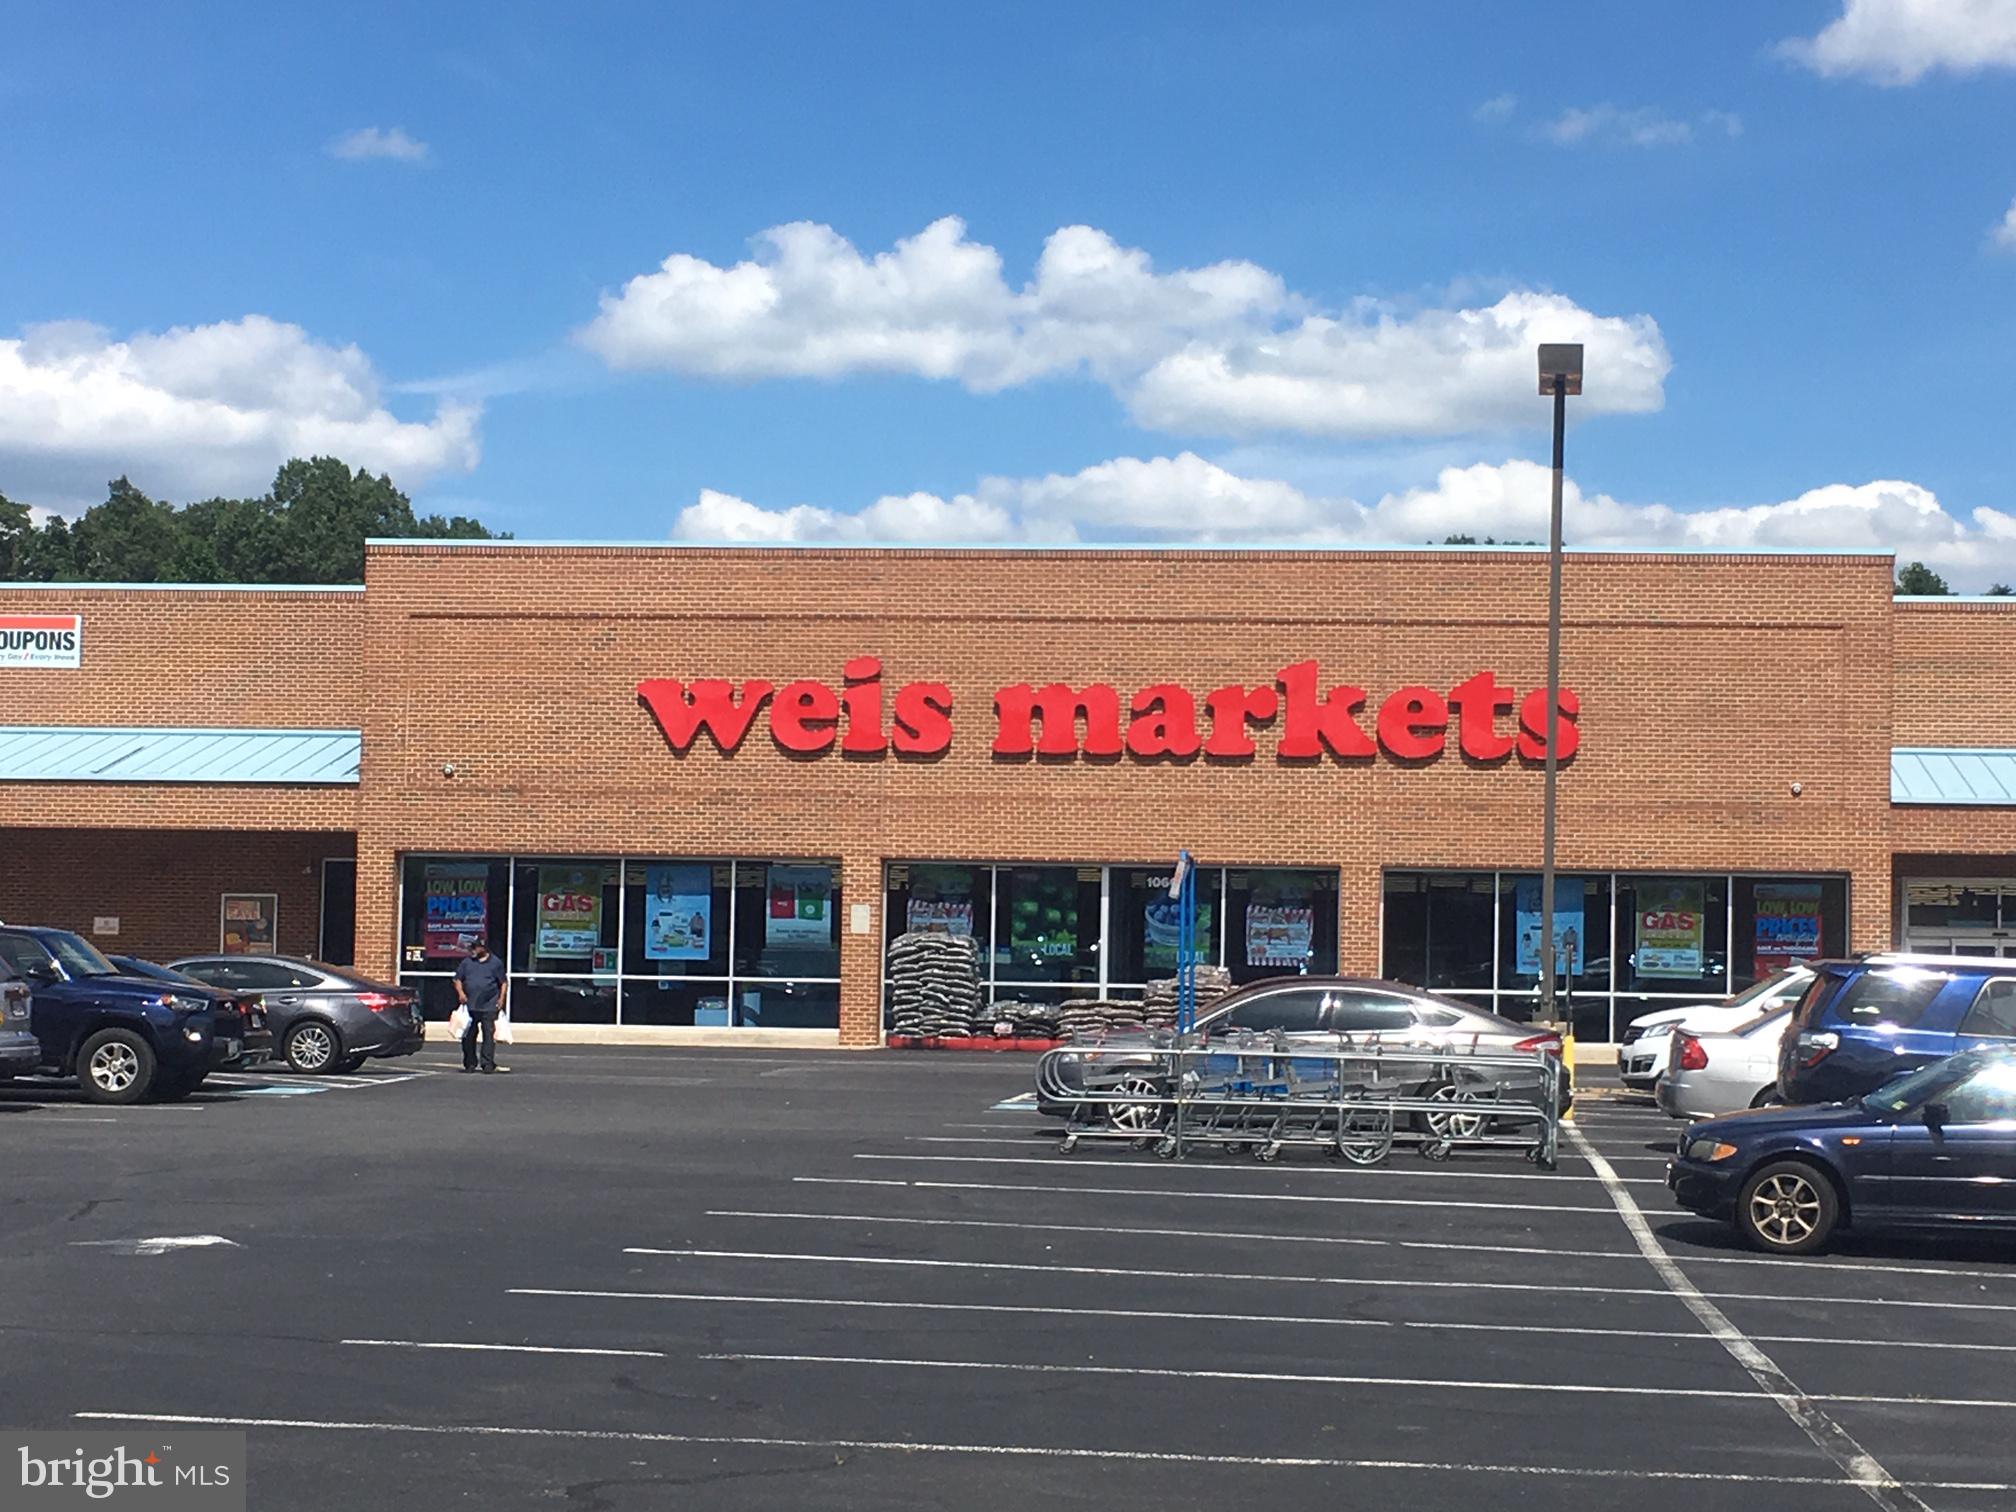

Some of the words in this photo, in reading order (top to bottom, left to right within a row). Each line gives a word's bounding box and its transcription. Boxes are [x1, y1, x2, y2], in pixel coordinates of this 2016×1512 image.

[637, 657, 952, 759] weis
[993, 659, 1579, 760] markets
[428, 896, 484, 913] PRICES
[543, 893, 593, 912] GAS
[1642, 911, 1696, 931] GAS
[1043, 943, 1074, 956] LOCAL
